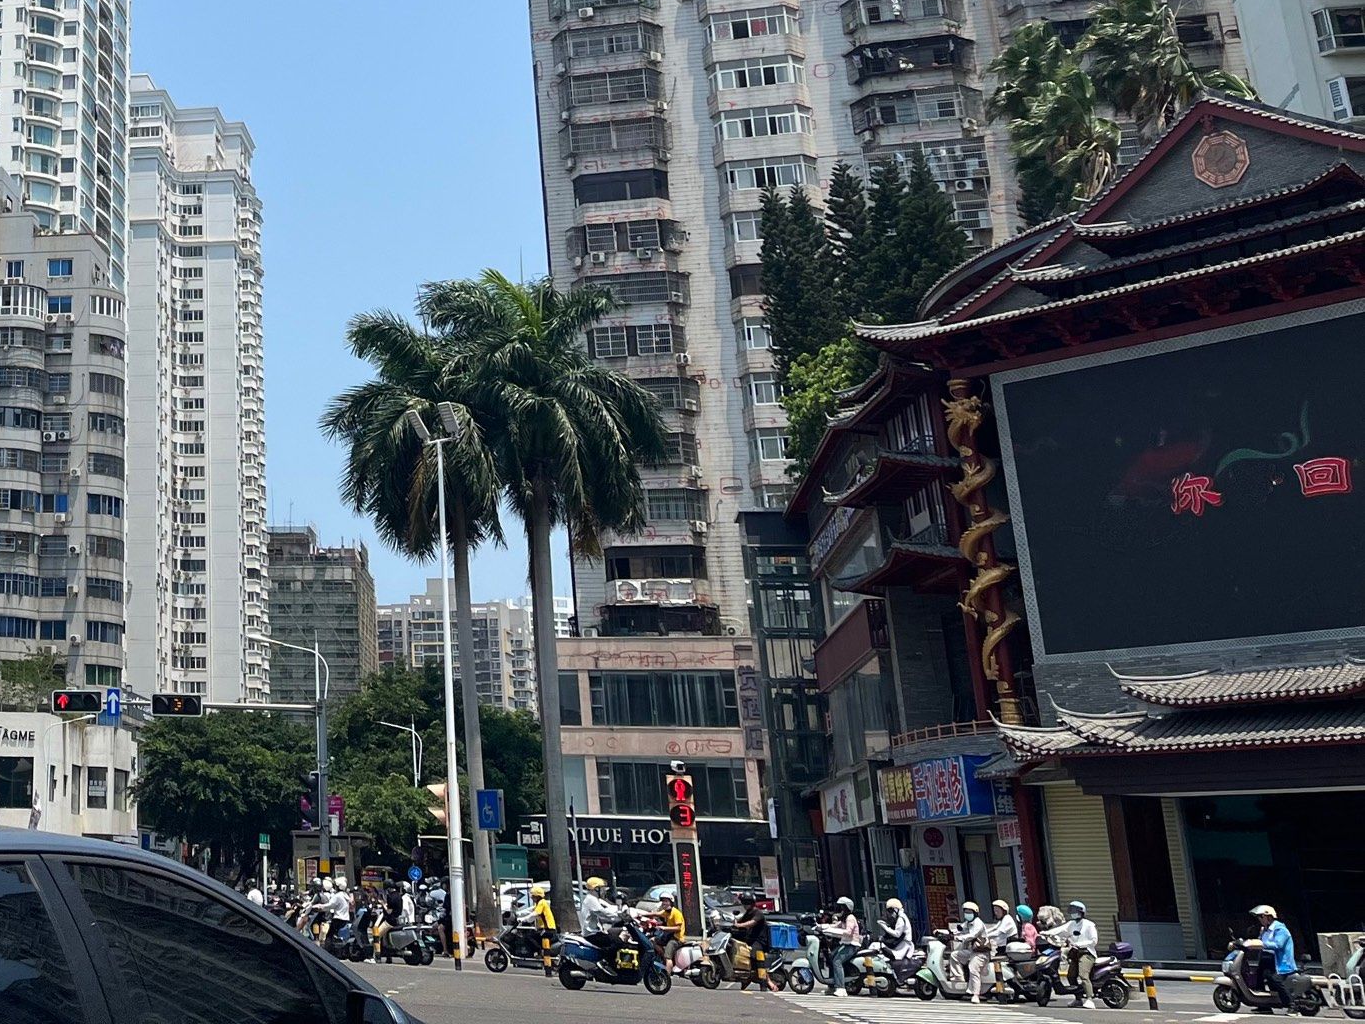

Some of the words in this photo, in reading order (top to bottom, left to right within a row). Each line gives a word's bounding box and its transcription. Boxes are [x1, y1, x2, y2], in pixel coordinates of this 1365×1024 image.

[1171, 473, 1223, 516] 你
[1293, 457, 1351, 497] 回
[568, 827, 623, 846] YIJUE
